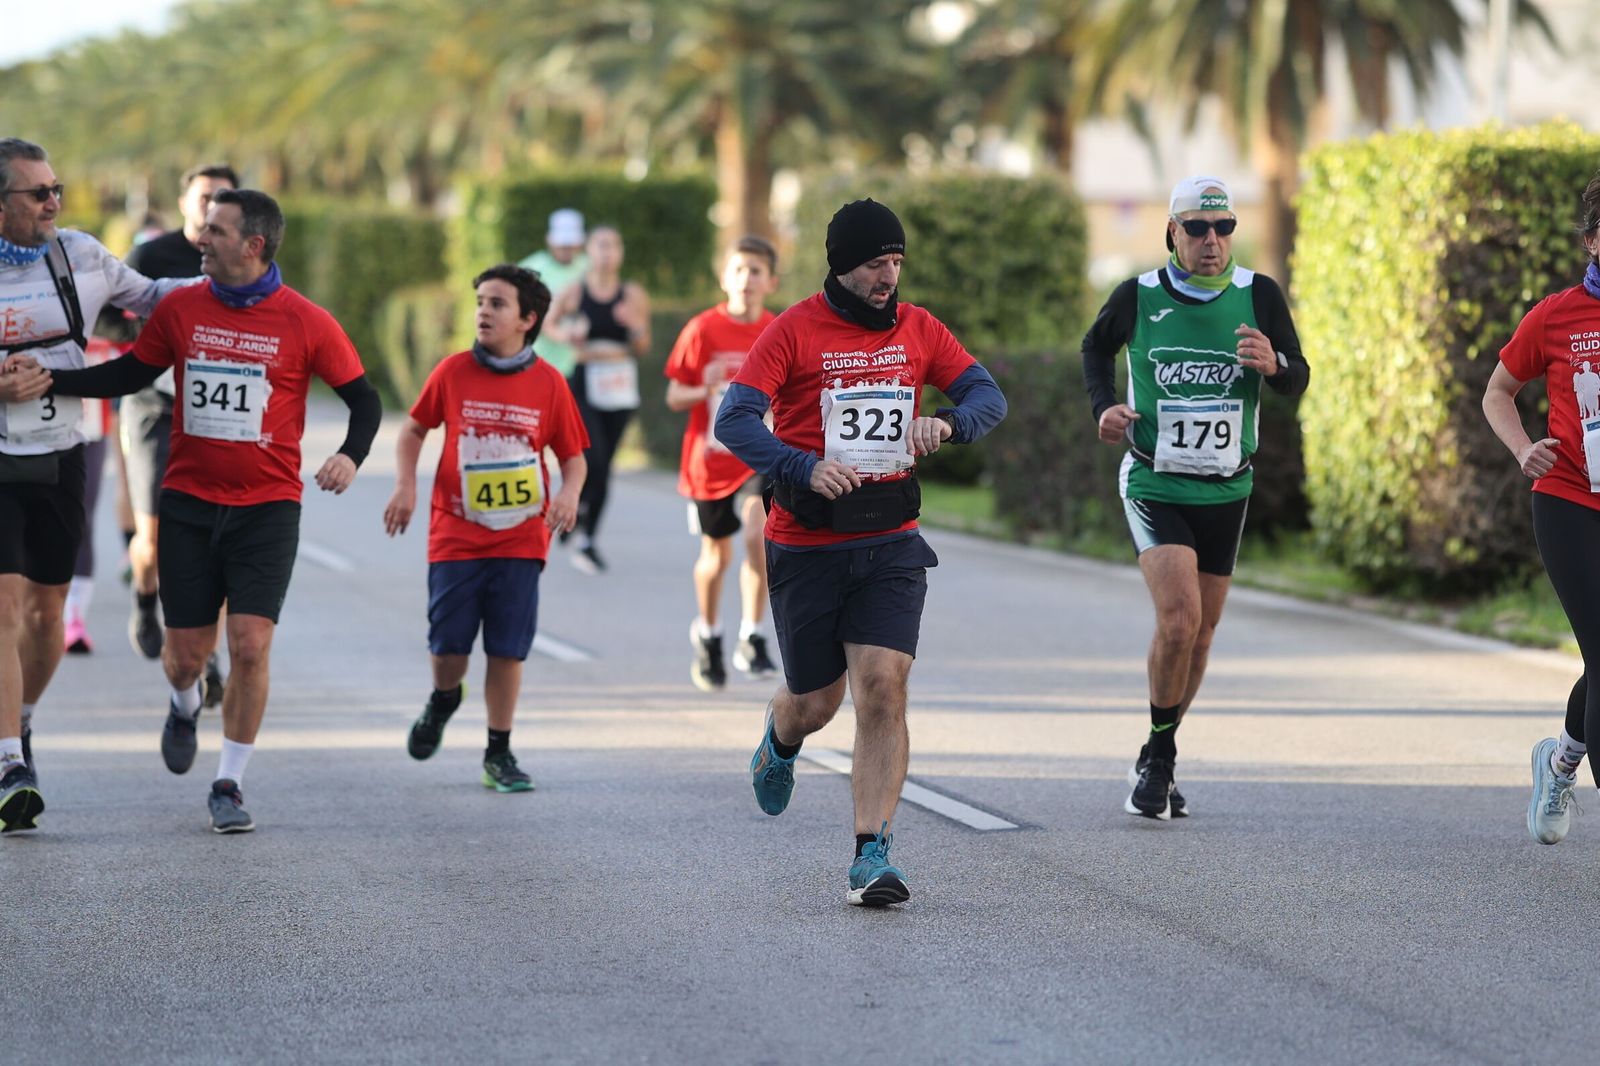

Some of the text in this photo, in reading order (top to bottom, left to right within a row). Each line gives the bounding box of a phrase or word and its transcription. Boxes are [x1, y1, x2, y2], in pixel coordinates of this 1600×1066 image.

[192, 332, 233, 348] CIUDAD
[236, 340, 279, 355] JARDÍN
[1571, 340, 1600, 352] CIUD
[1582, 331, 1600, 339] CAR
[822, 351, 907, 371] CIUDAD JARDÍN
[834, 351, 869, 359] CARRERA
[869, 345, 898, 358] URBANA
[897, 344, 905, 352] DE
[1159, 362, 1234, 384] CASTRO
[191, 379, 251, 413] 341
[41, 394, 56, 421] 3
[462, 407, 501, 420] CIUDAD
[840, 407, 903, 442] 323
[1171, 420, 1231, 449] 179
[476, 479, 531, 507] 415
